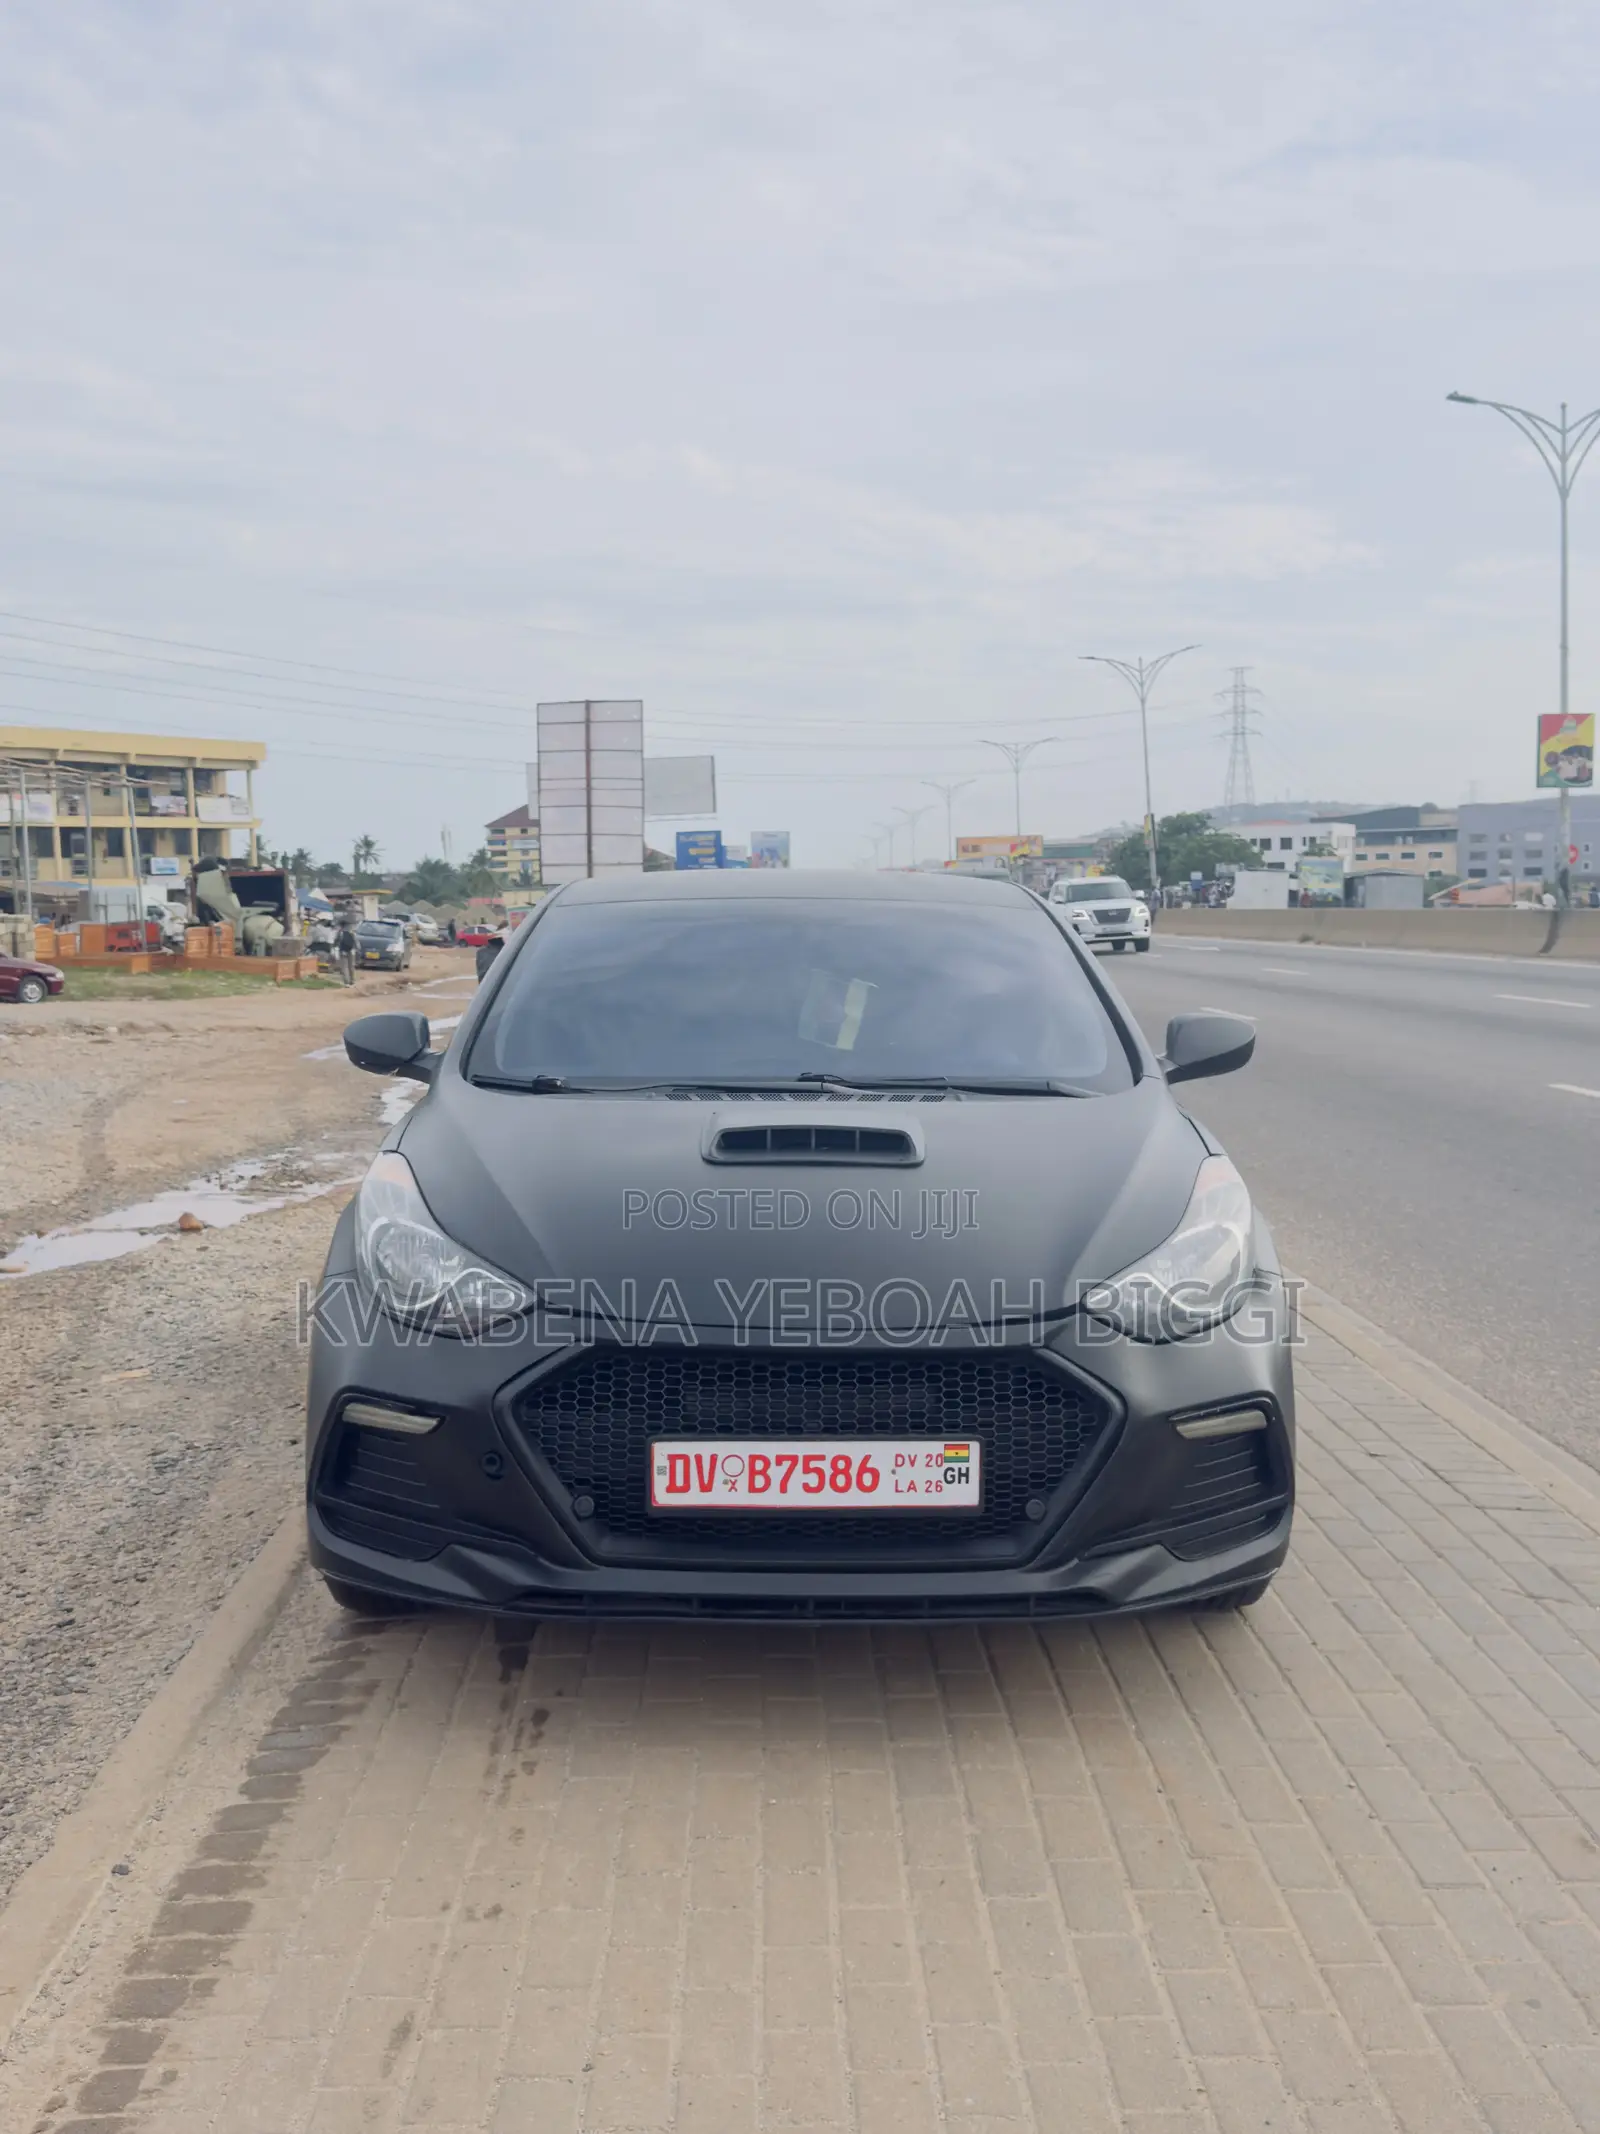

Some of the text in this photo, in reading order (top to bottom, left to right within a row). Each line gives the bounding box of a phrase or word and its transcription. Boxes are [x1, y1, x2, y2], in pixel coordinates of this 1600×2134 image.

[895, 1453, 944, 1468] DV 20
[666, 1453, 881, 1494] DV B7586
[943, 1466, 970, 1485] GH
[895, 1479, 943, 1493] LA 26
